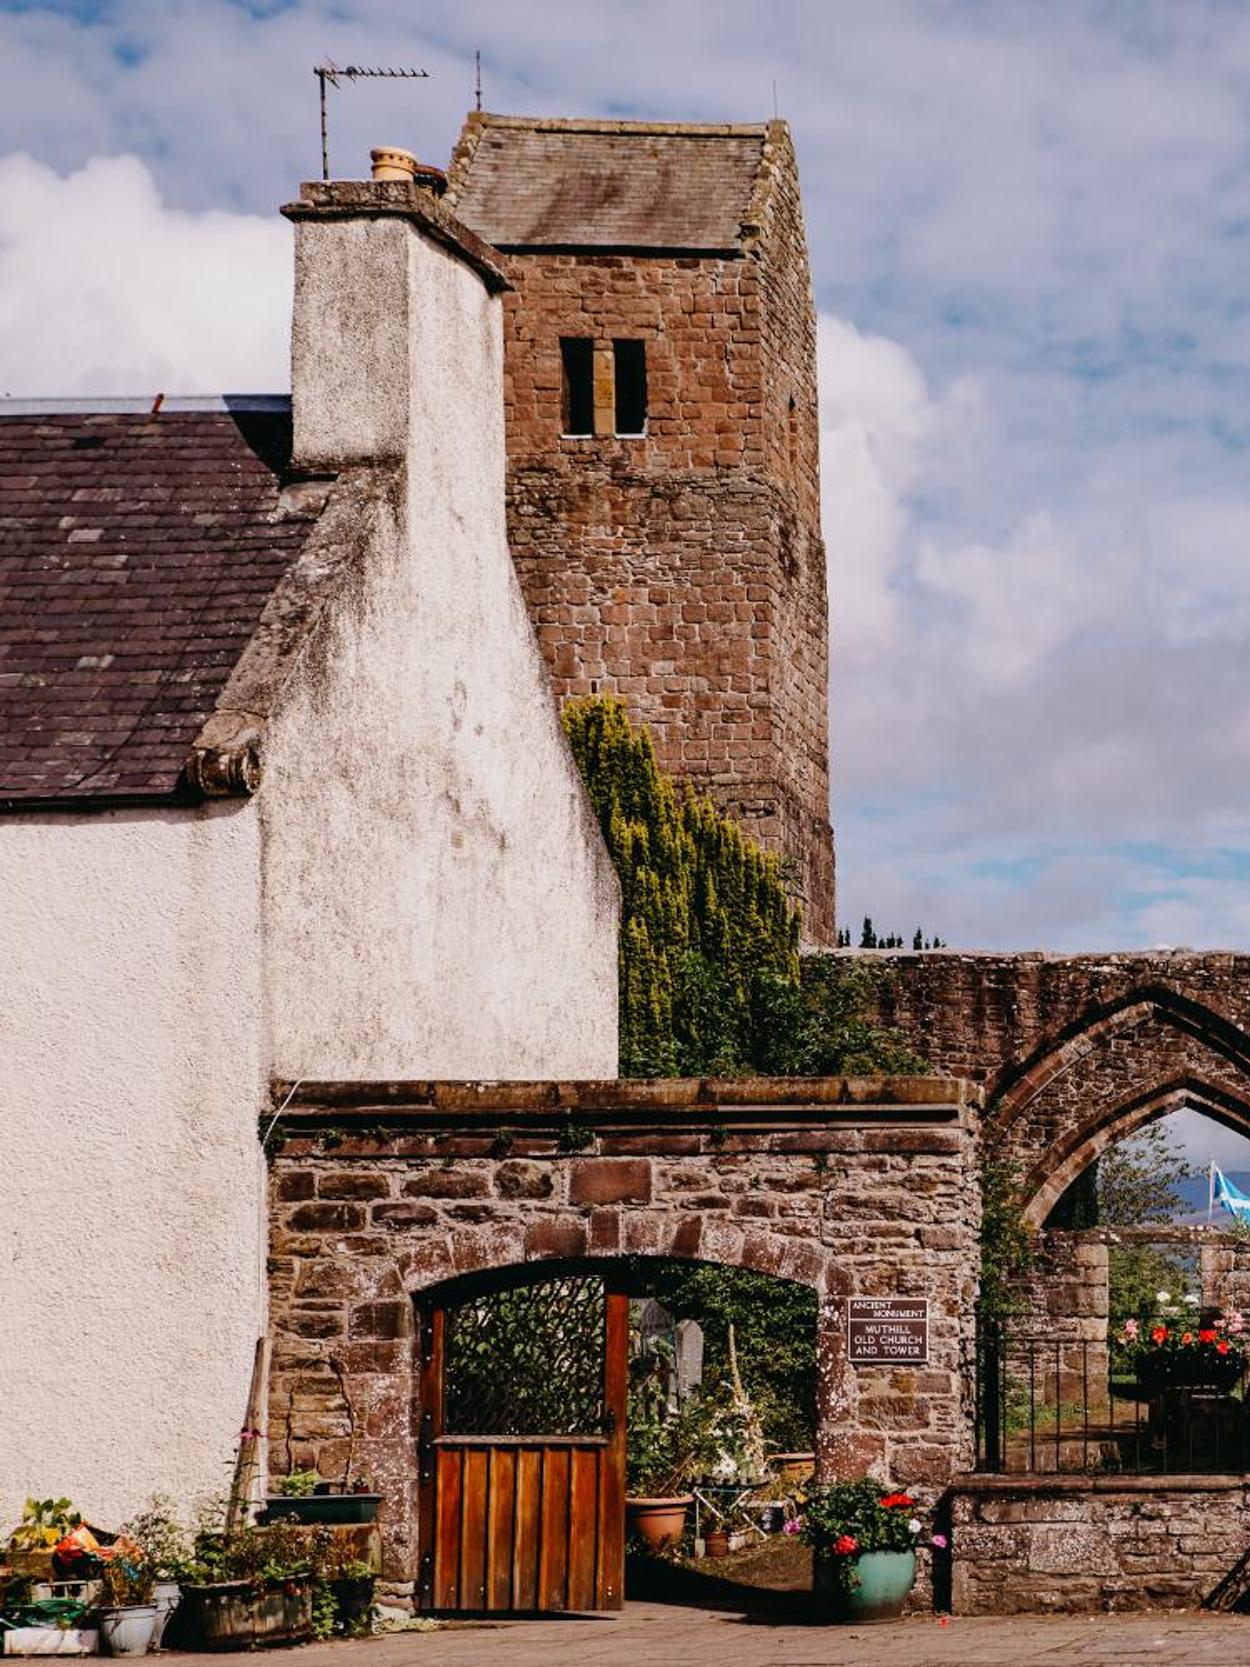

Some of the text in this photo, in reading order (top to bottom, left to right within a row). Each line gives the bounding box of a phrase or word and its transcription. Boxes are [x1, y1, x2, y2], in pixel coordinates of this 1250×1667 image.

[852, 1301, 892, 1309] ANCIENT
[873, 1309, 925, 1318] MONUMENT
[865, 1325, 911, 1334] MUTHILL
[854, 1335, 923, 1345] OLD CHURCH
[856, 1346, 920, 1355] AND TOWER
